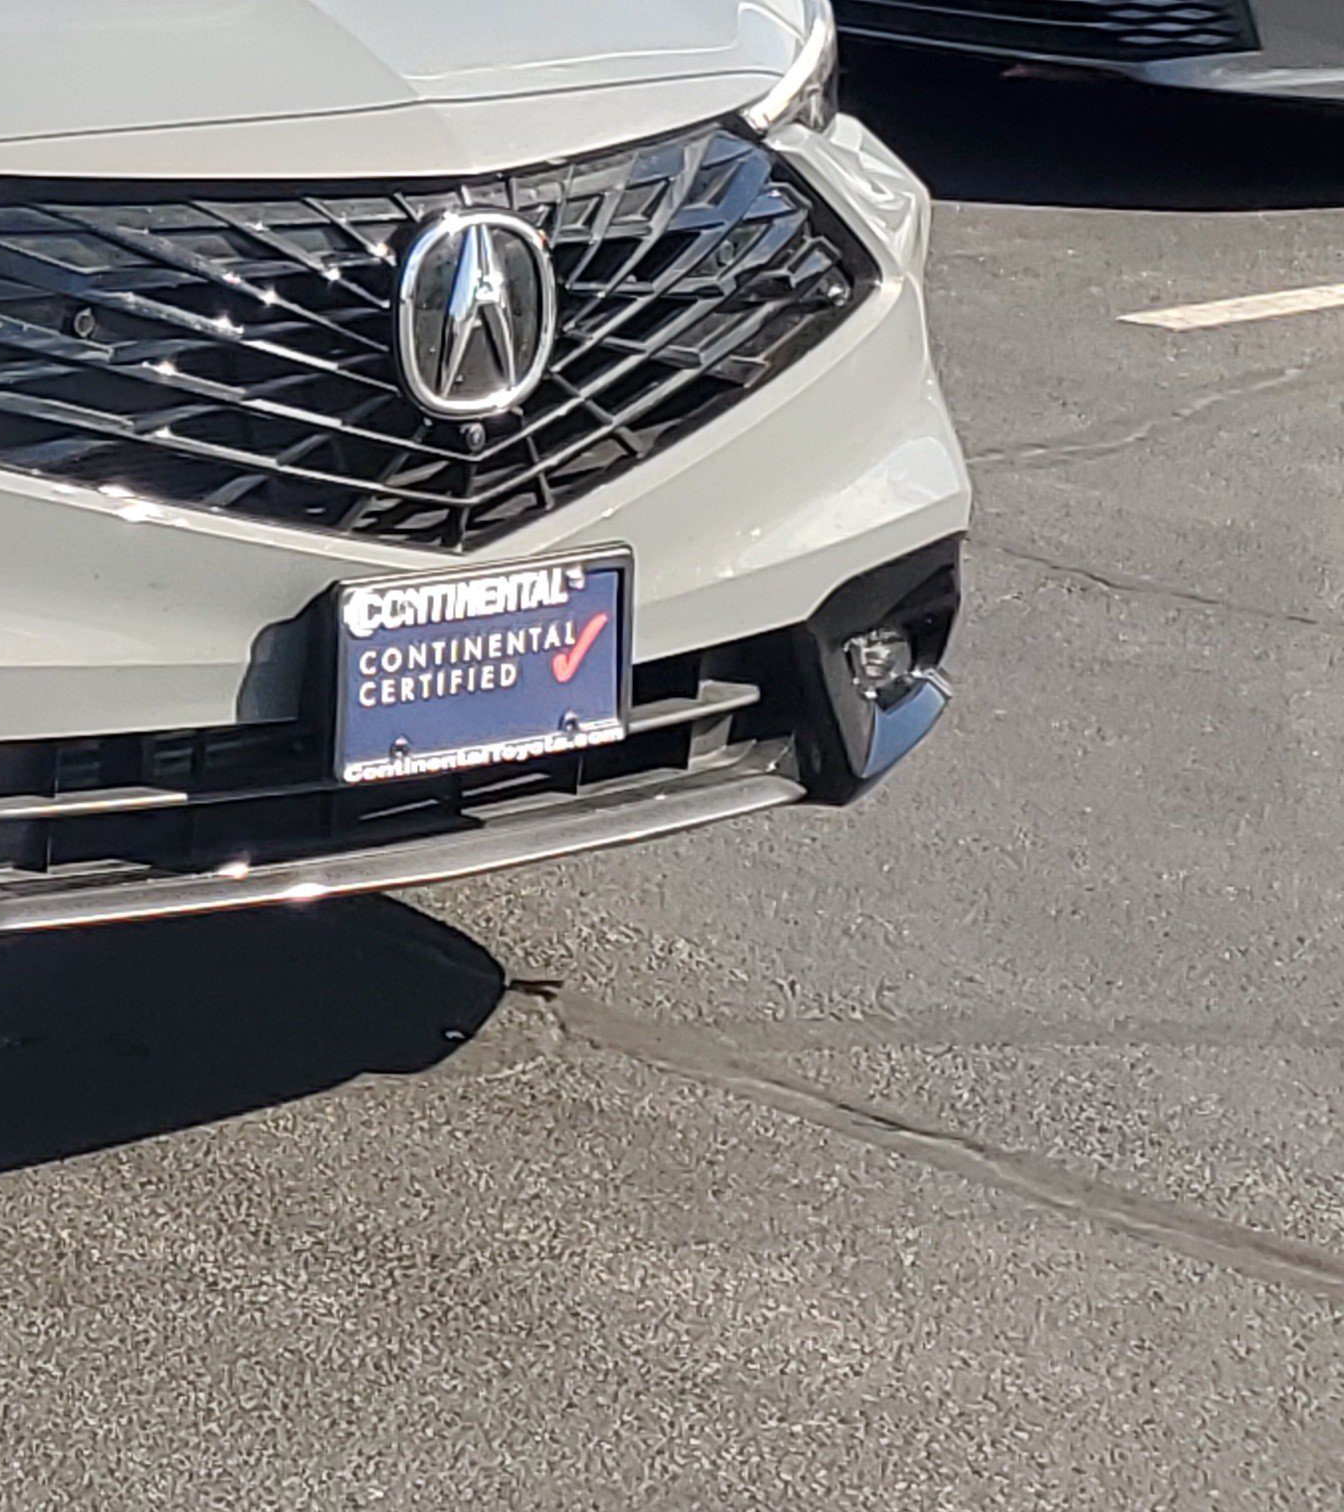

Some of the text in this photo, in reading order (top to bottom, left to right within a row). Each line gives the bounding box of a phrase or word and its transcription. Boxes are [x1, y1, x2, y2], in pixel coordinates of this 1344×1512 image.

[344, 568, 568, 636] CONTINENTAL
[359, 621, 577, 676] CONTINENTAL
[359, 663, 518, 707] CERTIFIED
